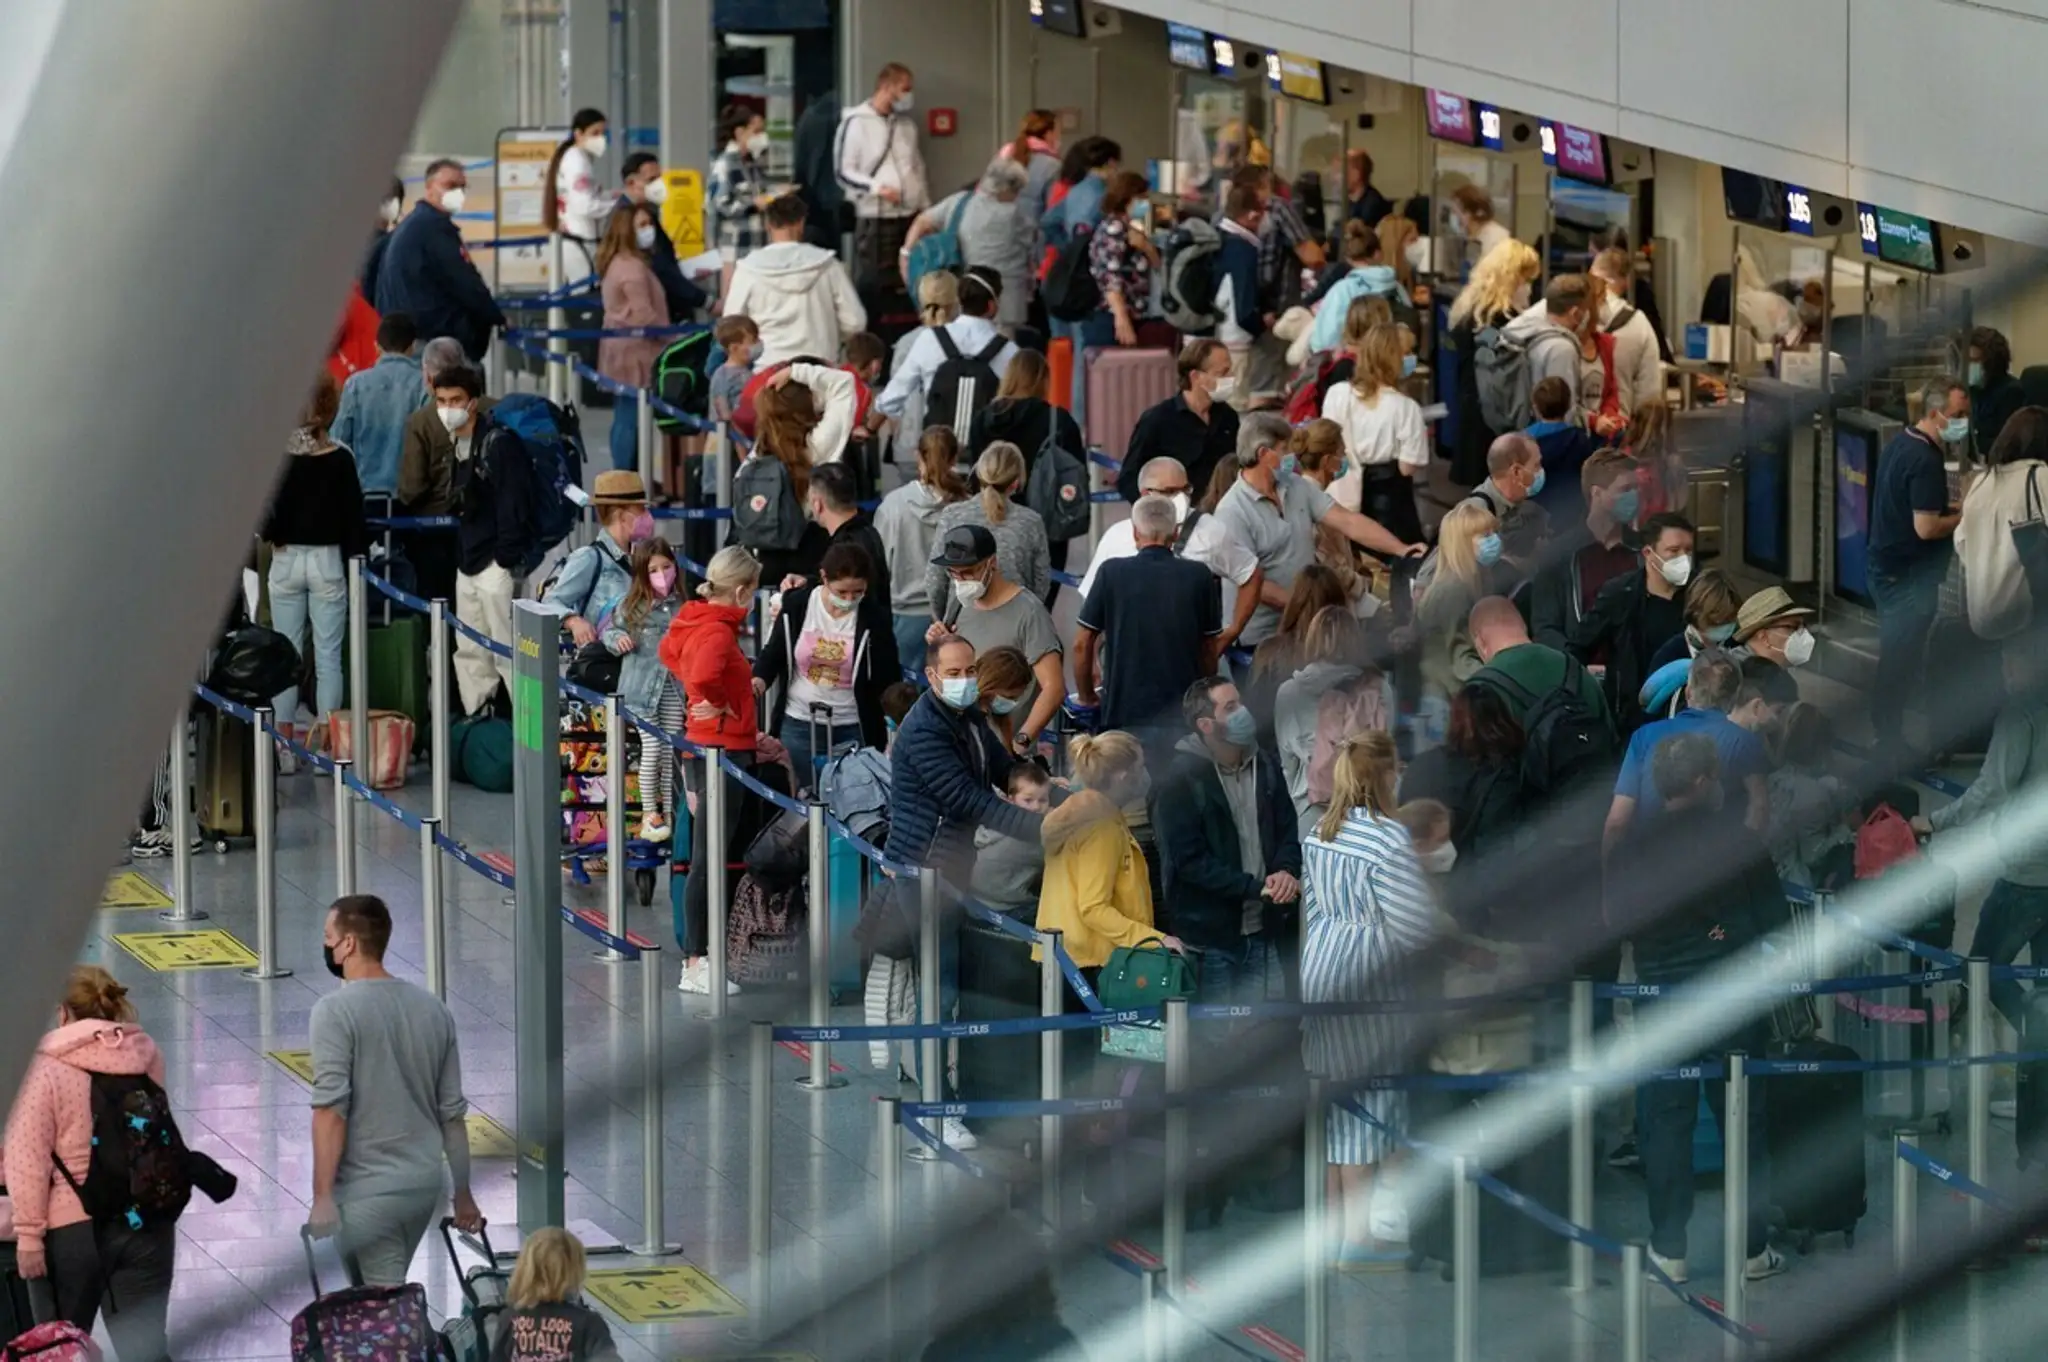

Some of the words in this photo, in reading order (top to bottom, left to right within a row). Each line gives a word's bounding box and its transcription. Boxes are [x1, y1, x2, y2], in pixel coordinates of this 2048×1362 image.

[1638, 985, 1660, 996] DUS
[1790, 982, 1811, 993] DUS
[1117, 1011, 1139, 1023] DUS
[1230, 1006, 1252, 1017] DUS
[819, 1029, 840, 1040] DUS
[968, 1024, 990, 1035] DUS
[1680, 1067, 1701, 1078] DUS
[1798, 1063, 1820, 1073] DUS
[945, 1104, 968, 1116] DUS
[1102, 1099, 1123, 1110] DUS
[540, 1317, 573, 1333] LOOK
